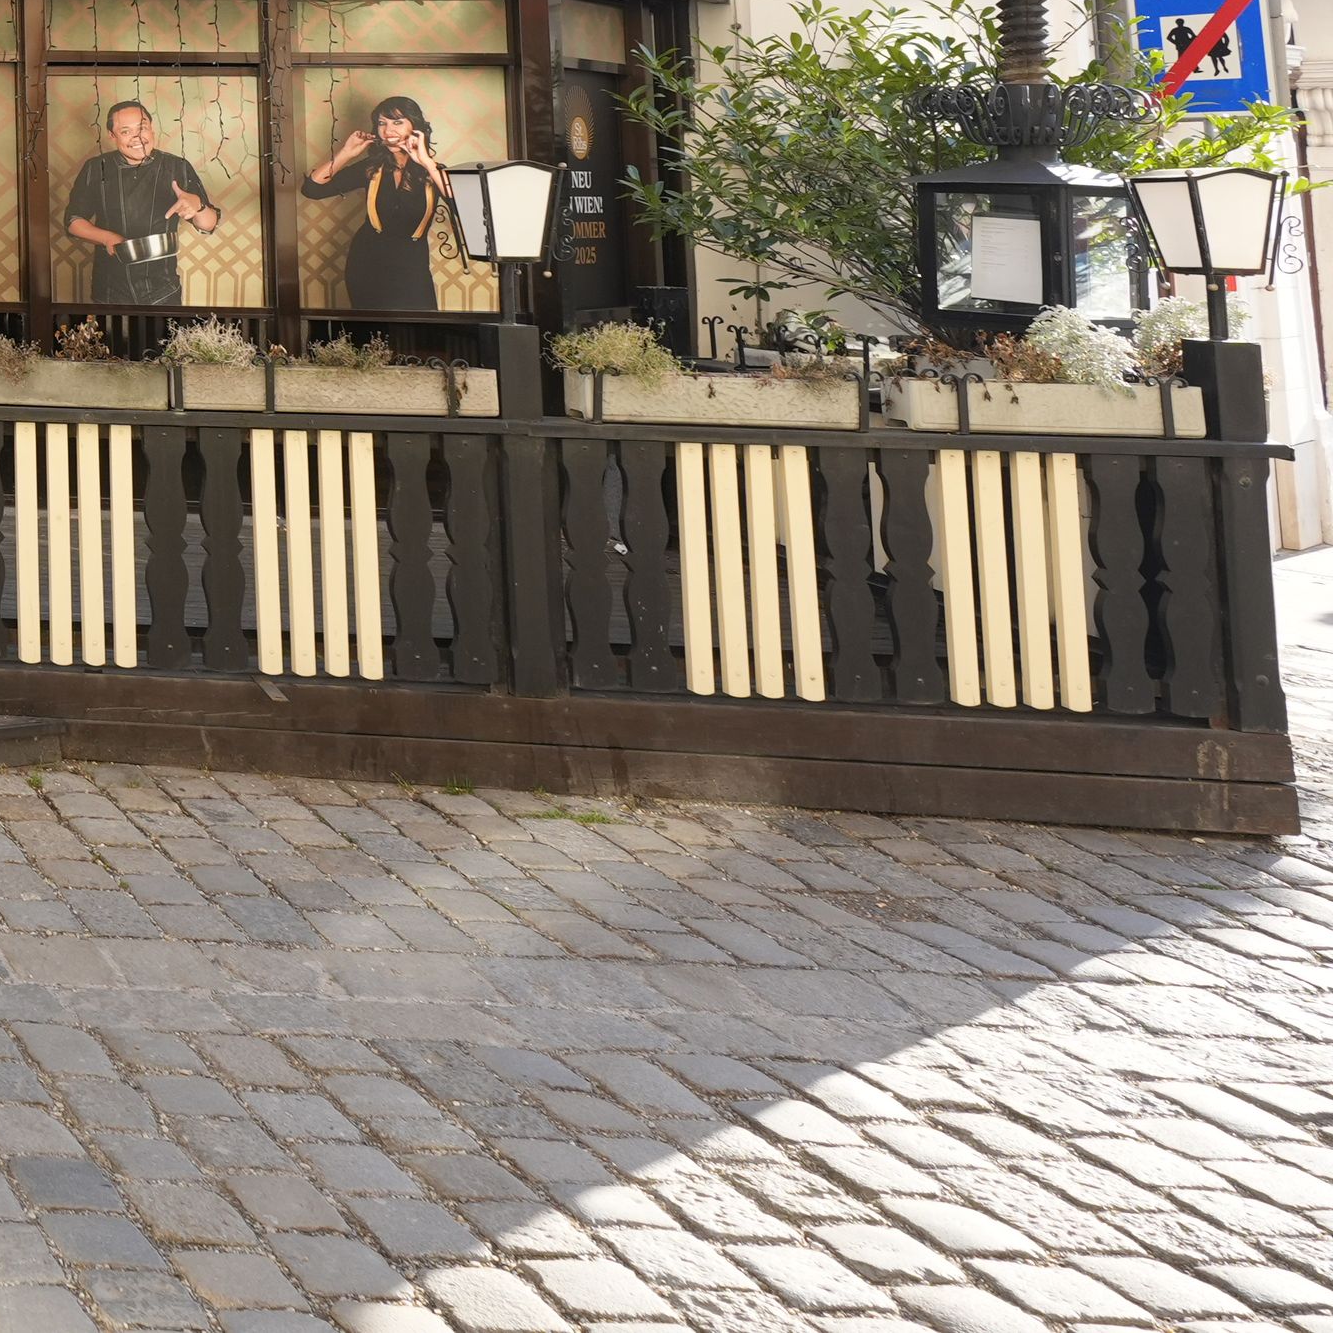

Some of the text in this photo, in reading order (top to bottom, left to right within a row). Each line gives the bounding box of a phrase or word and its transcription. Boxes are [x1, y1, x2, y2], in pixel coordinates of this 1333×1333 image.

[571, 170, 592, 189] NEU
[575, 196, 604, 214] WIEN!
[572, 220, 606, 239] MMER
[575, 246, 597, 265] 2025
